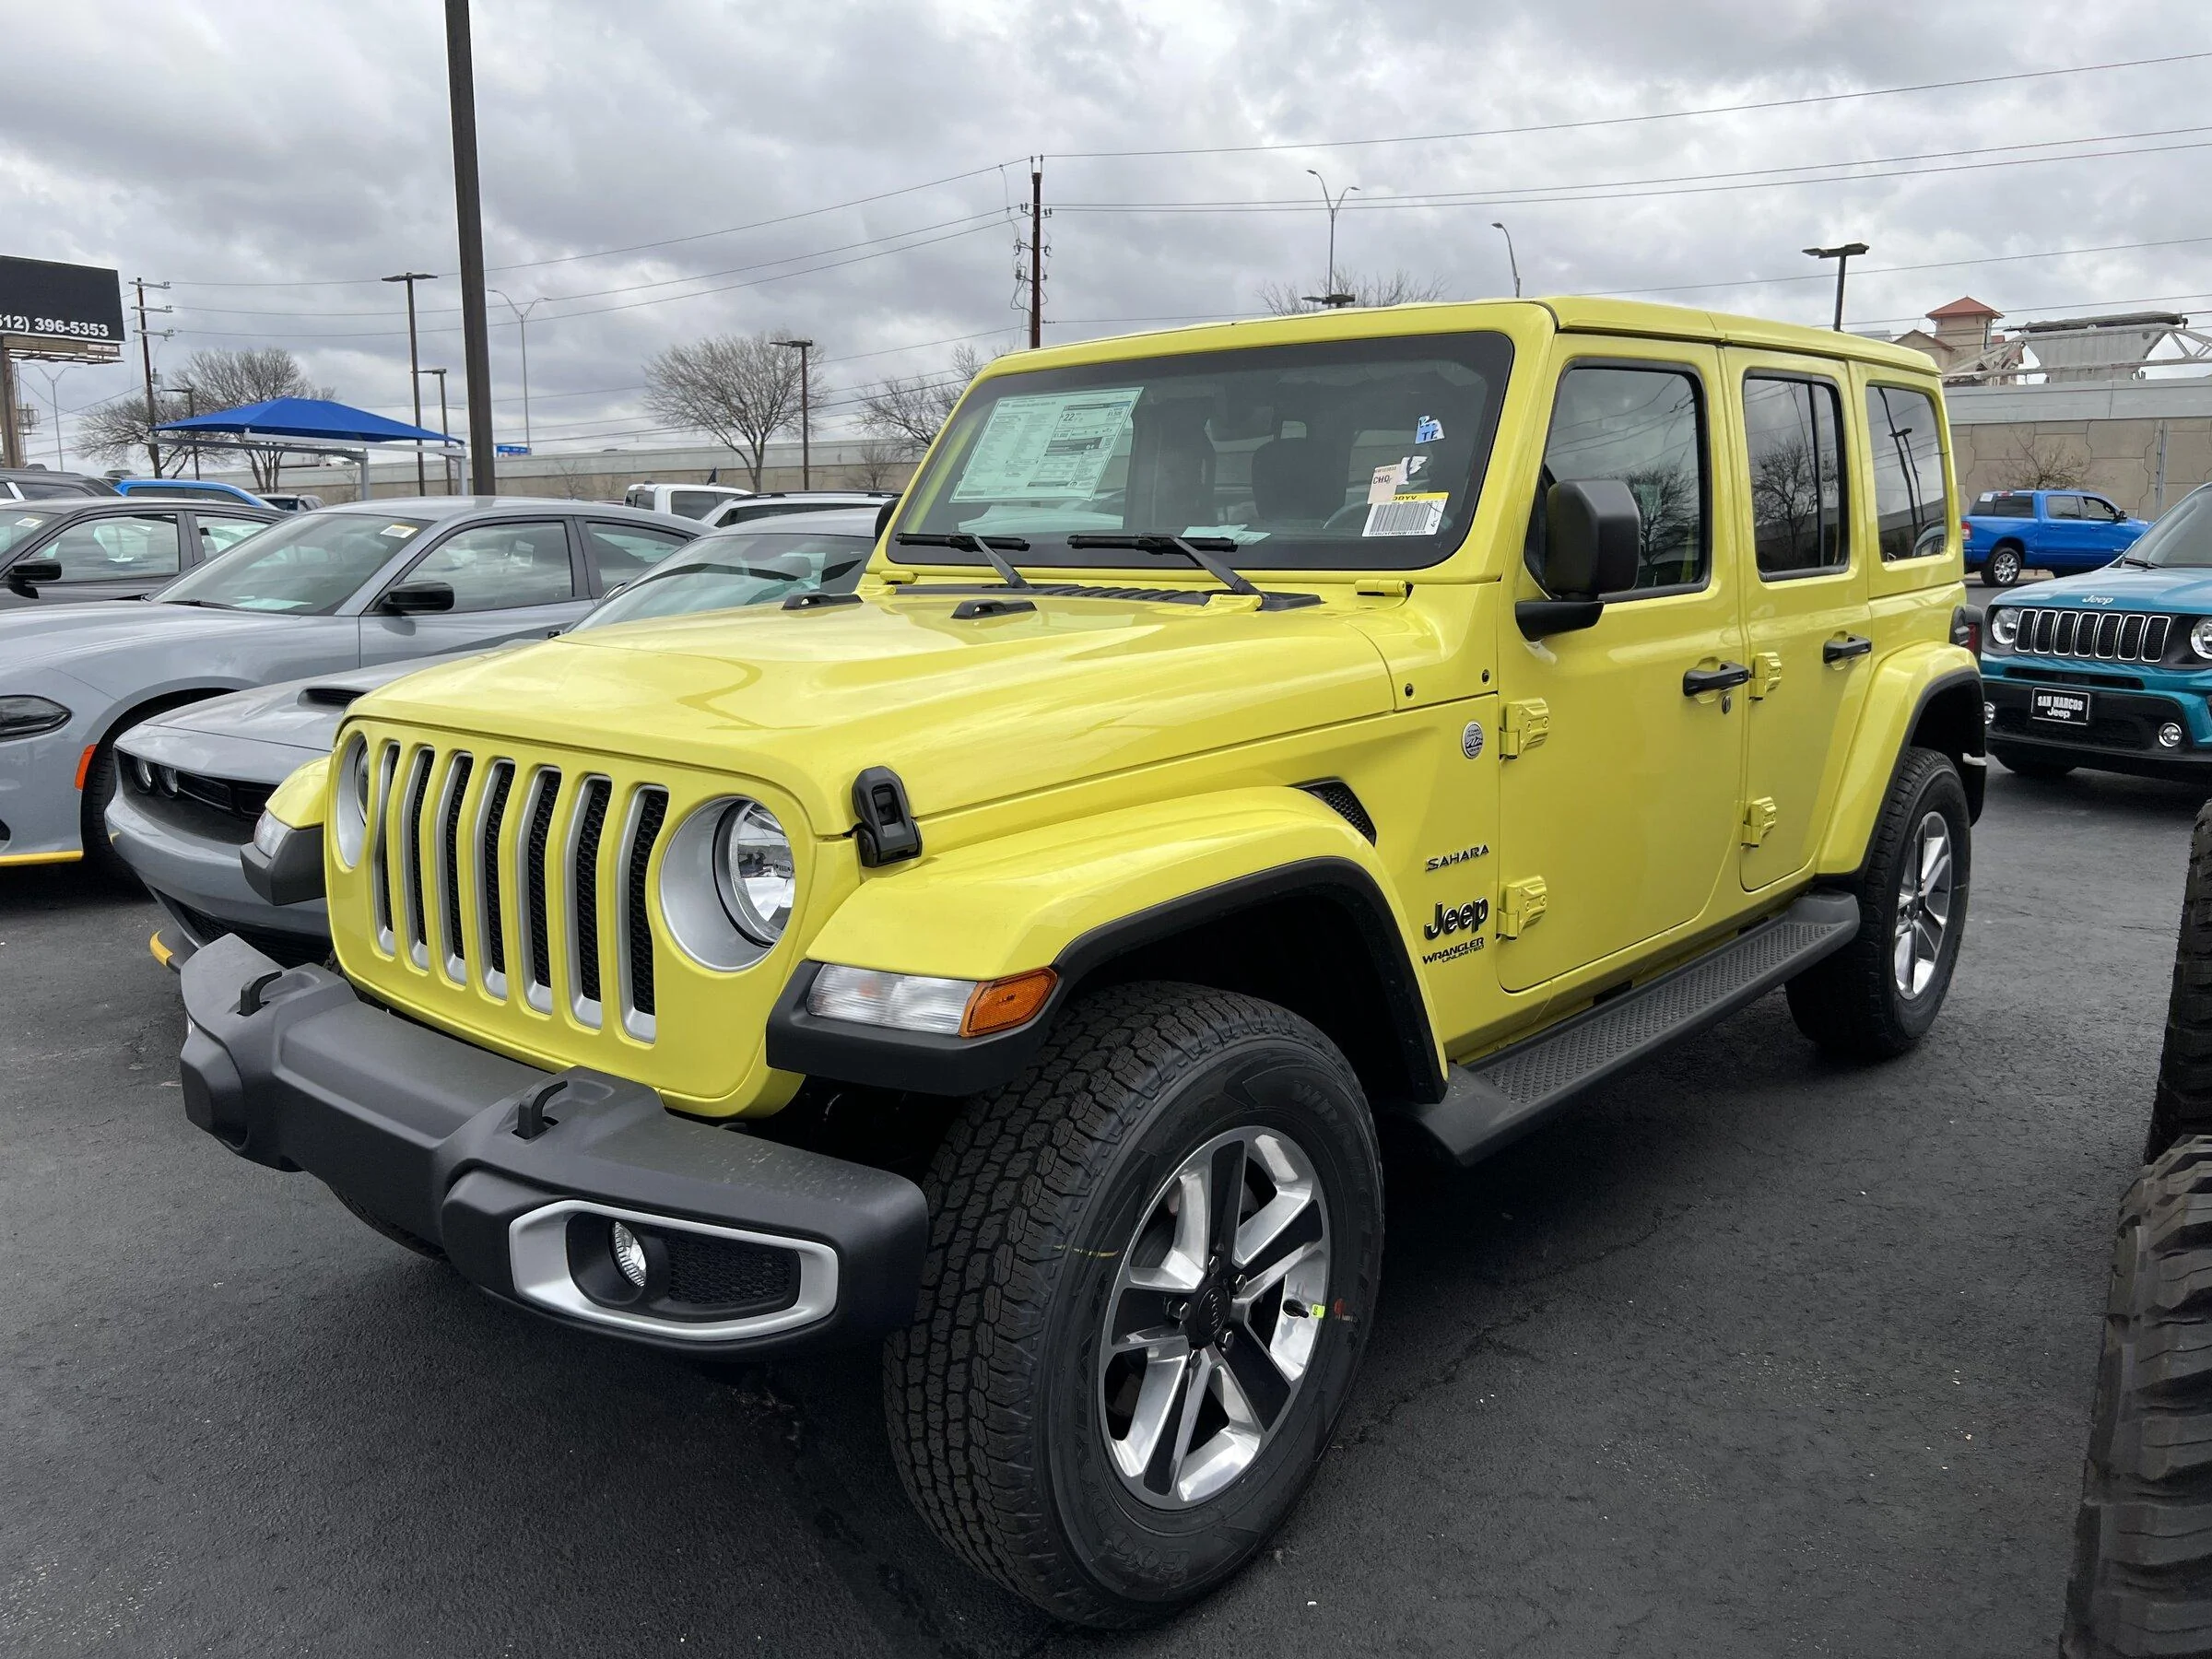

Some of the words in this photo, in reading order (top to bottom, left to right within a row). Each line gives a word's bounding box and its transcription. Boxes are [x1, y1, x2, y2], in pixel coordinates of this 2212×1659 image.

[0, 314, 30, 333] 12)
[34, 317, 110, 337] 396-5353
[2081, 594, 2114, 606] Jeep
[2037, 696, 2053, 707] SAN
[2053, 696, 2083, 712] MARCOS
[2047, 706, 2071, 719] Jeep
[1425, 844, 1489, 874] SAHARA
[1424, 898, 1489, 941] Jeep
[1422, 937, 1485, 965] WRANGLER
[1441, 945, 1485, 963] UNLIMITED
